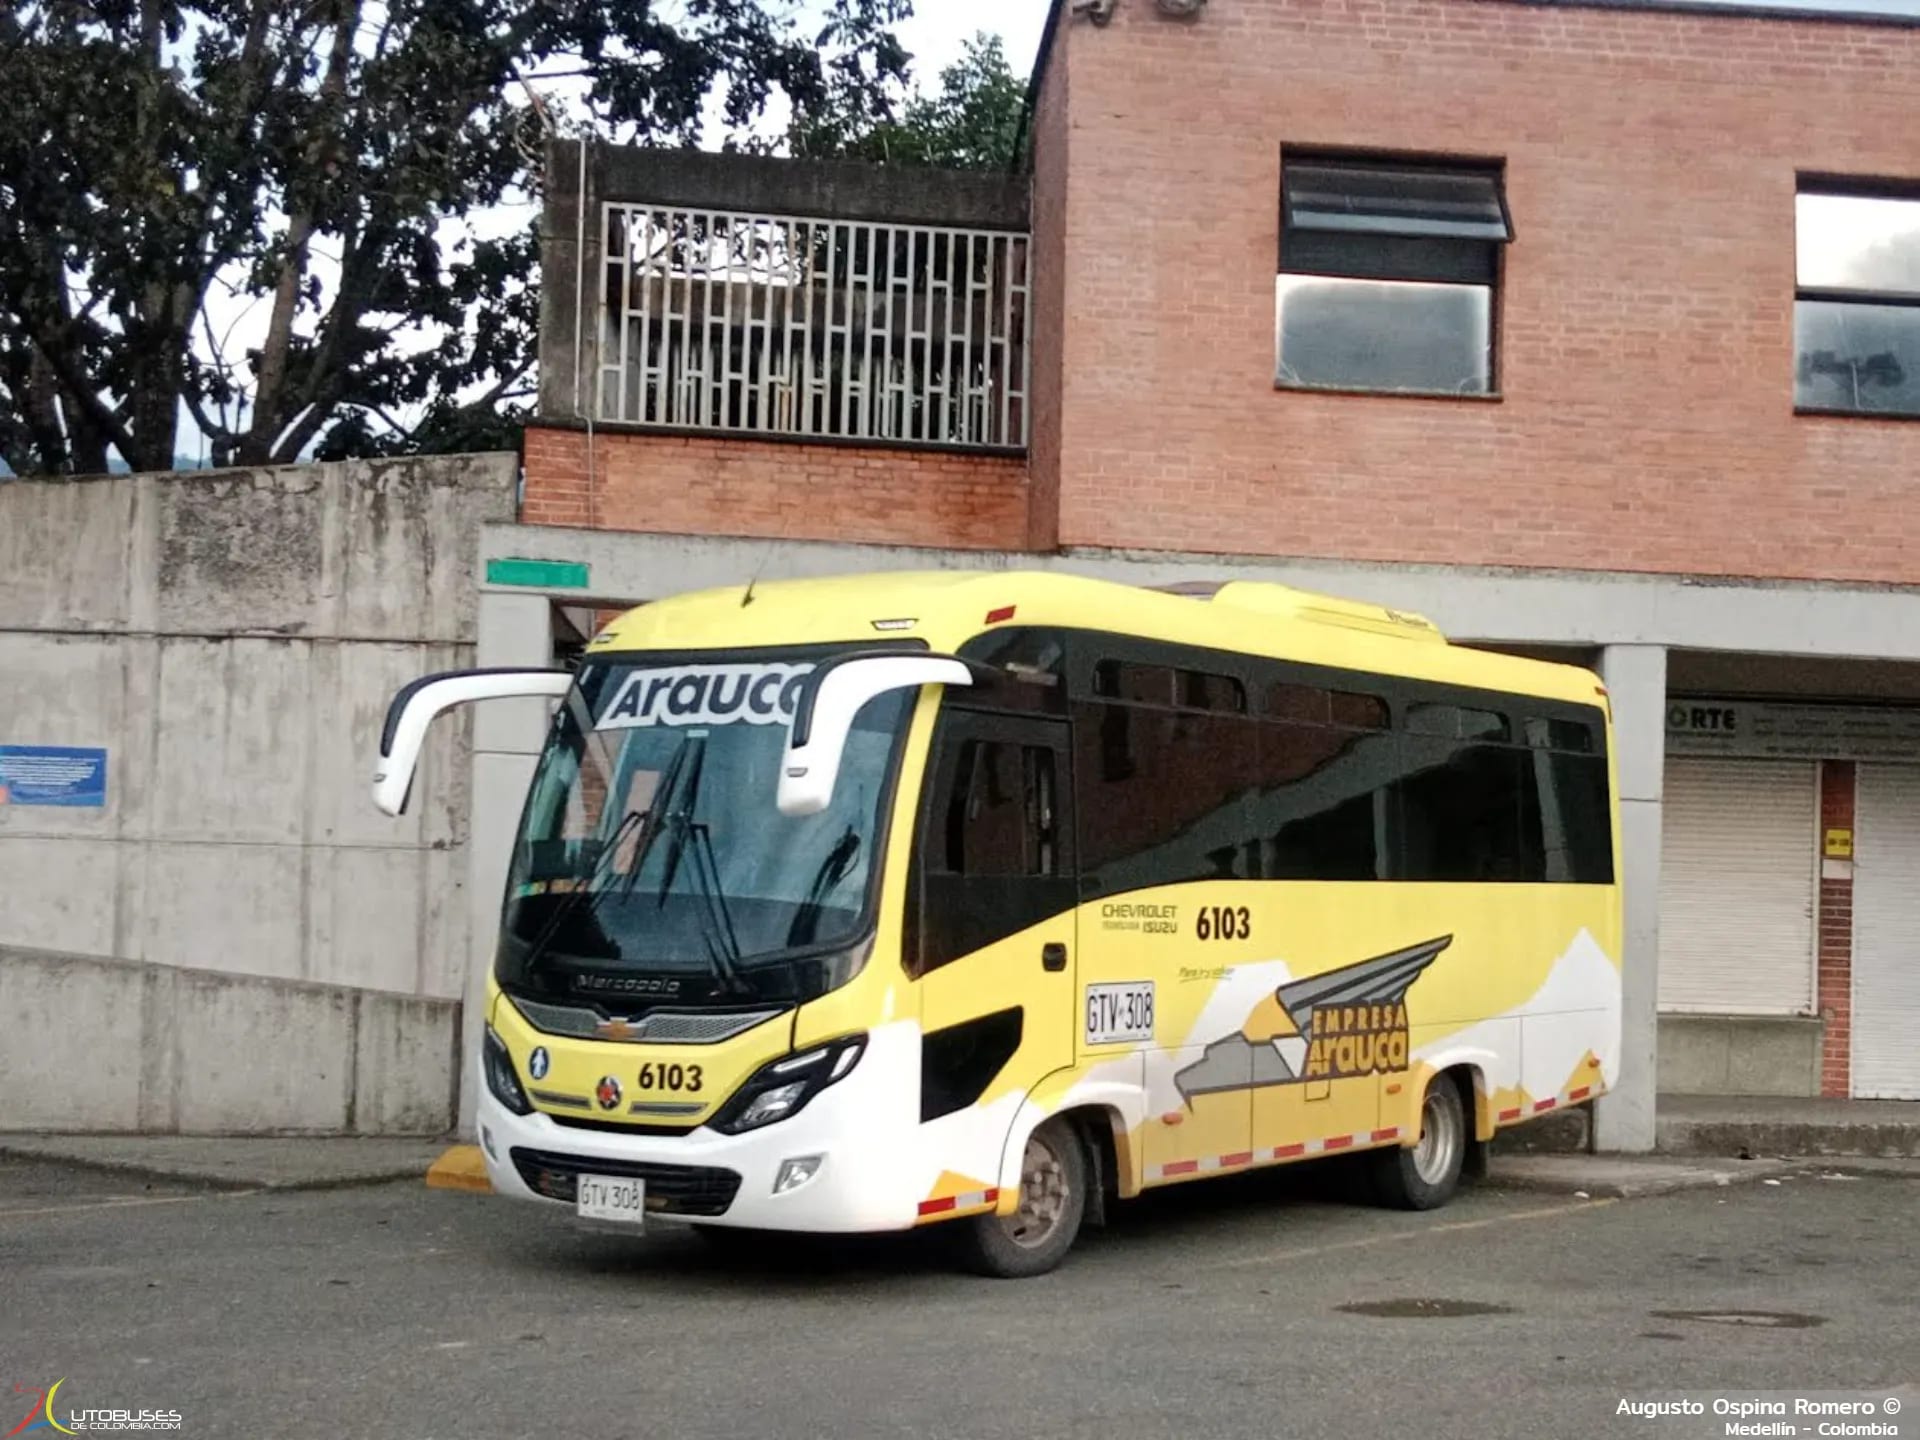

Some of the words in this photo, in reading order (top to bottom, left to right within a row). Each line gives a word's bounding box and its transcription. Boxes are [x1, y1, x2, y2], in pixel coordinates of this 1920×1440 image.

[1102, 904, 1178, 919] CHEVROLET
[1196, 906, 1250, 940] 6103
[1143, 921, 1178, 934] ISUZU
[577, 974, 681, 993] Marcopolo
[1312, 1003, 1407, 1035] EMPRESA
[638, 1062, 703, 1092] 6103
